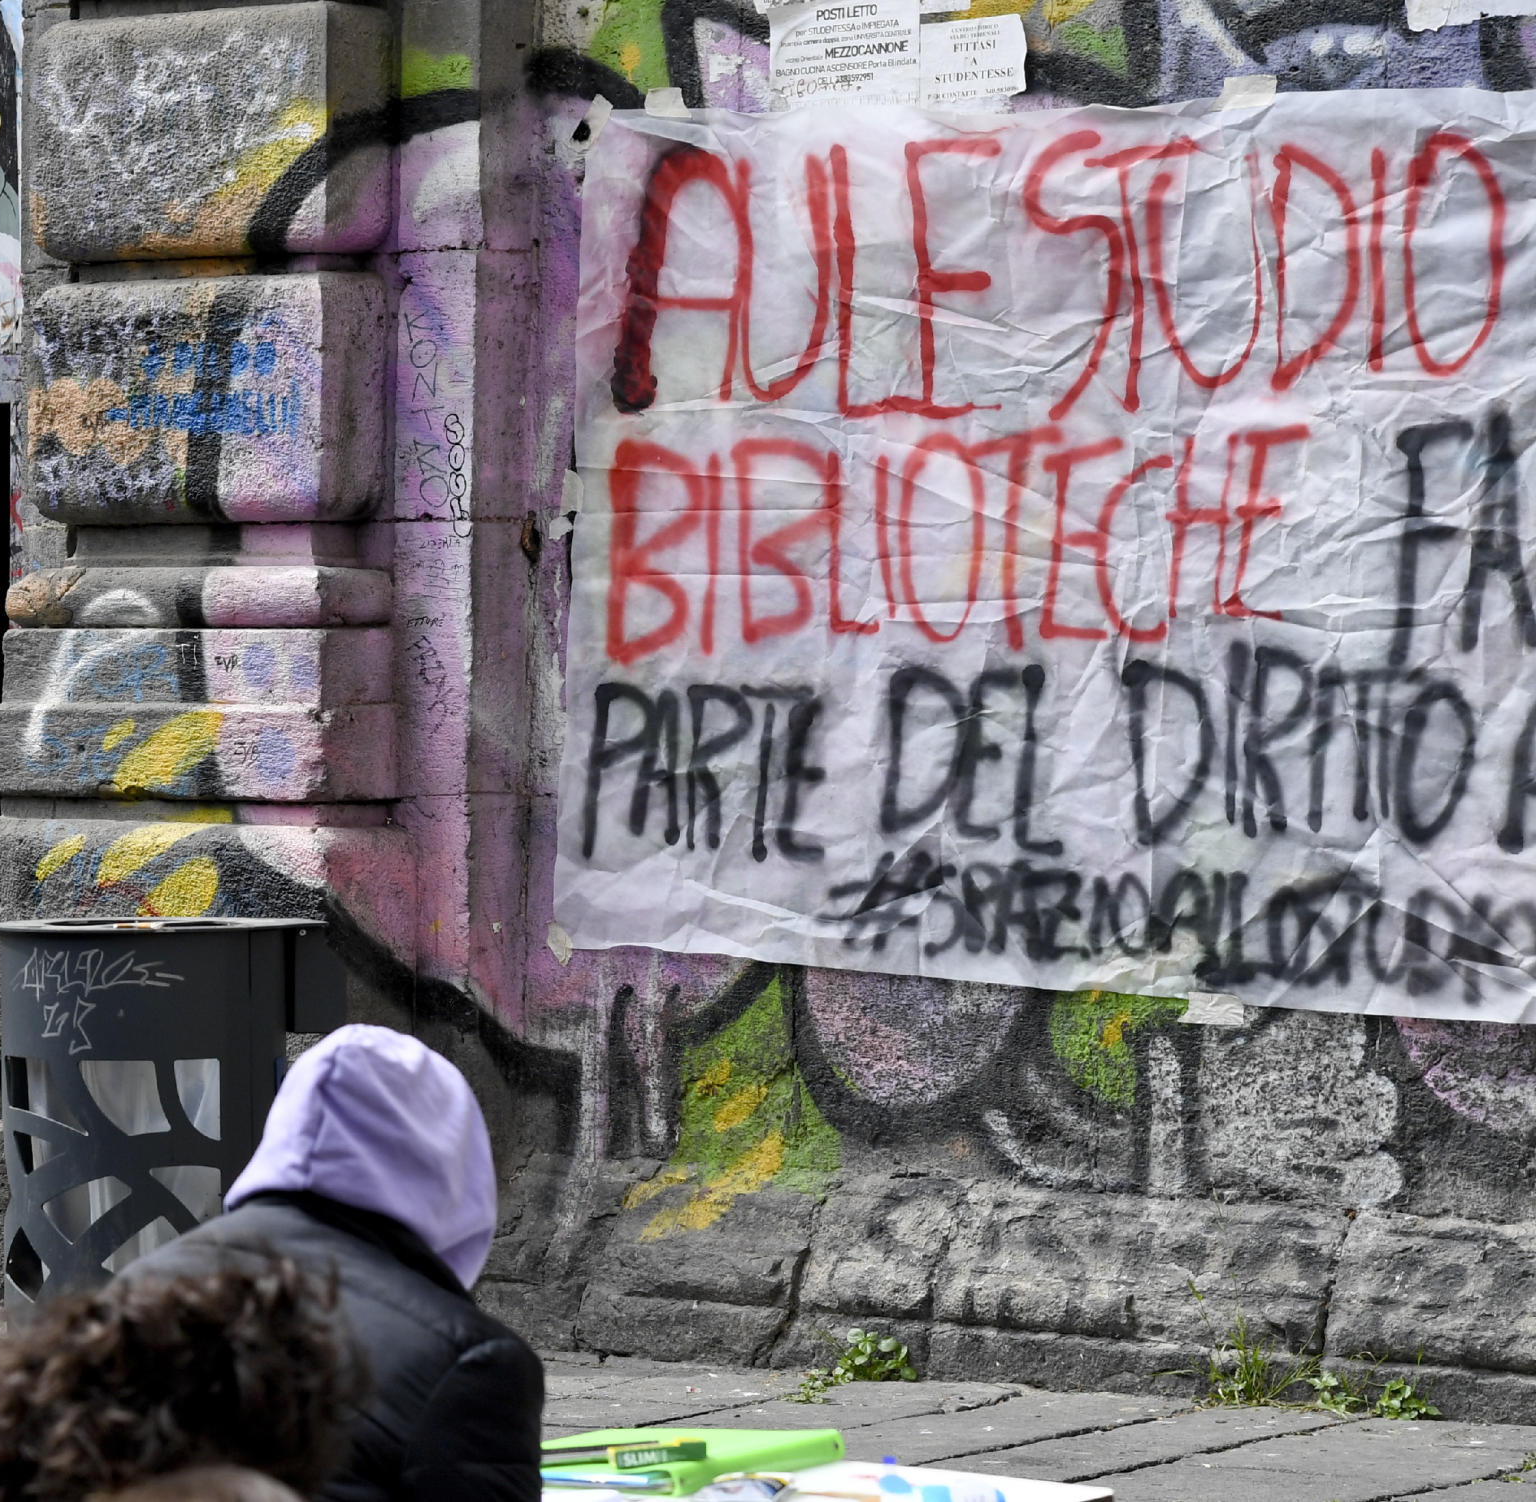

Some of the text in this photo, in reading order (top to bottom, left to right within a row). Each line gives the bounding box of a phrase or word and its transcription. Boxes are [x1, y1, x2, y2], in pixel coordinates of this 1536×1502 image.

[817, 4, 878, 21] POSTI LETTO
[825, 40, 909, 60] MEZZOCANNONE
[953, 40, 997, 53] FITTASI
[776, 68, 800, 77] BAGNO
[801, 66, 825, 75] CUCINA
[935, 67, 1014, 84] STUDENTESSE
[610, 128, 1508, 420] AULE STUDIO
[606, 424, 1311, 664] BIBLIOTECHE
[584, 680, 827, 862] PARTE
[877, 662, 1063, 856] DEL
